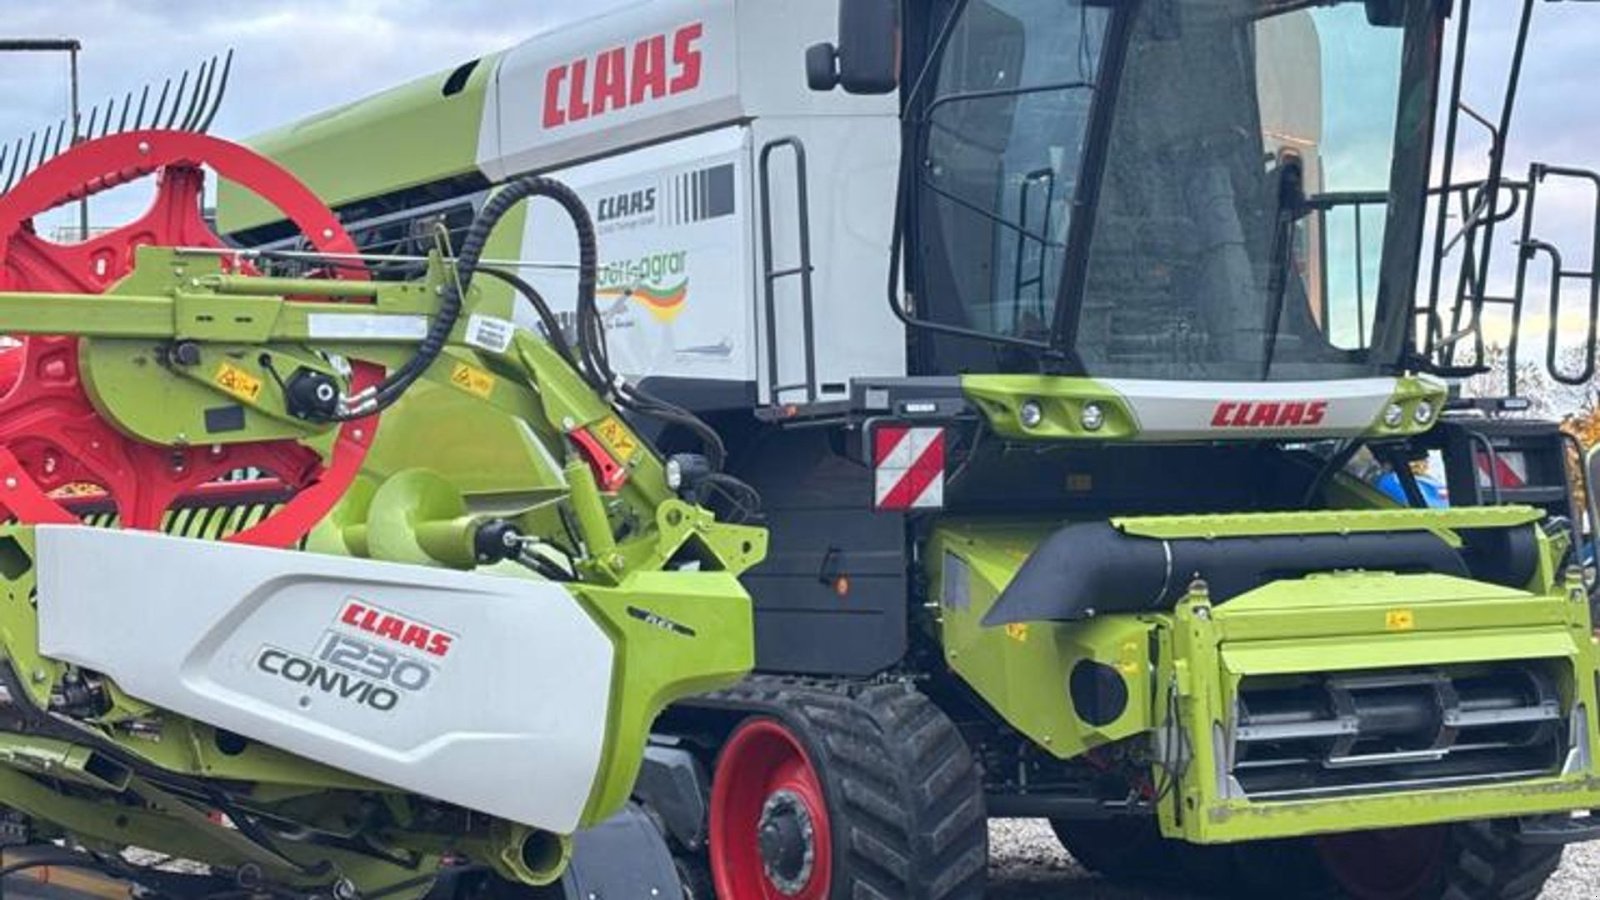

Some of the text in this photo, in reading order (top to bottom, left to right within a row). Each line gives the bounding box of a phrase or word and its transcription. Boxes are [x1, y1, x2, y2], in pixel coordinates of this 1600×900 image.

[543, 23, 702, 128] CLAAS
[598, 187, 656, 221] CLAAS
[1210, 402, 1328, 426] CLAAS
[342, 603, 453, 656] CLAAS
[258, 649, 399, 711] CONVIO
[319, 634, 431, 691] 1230
